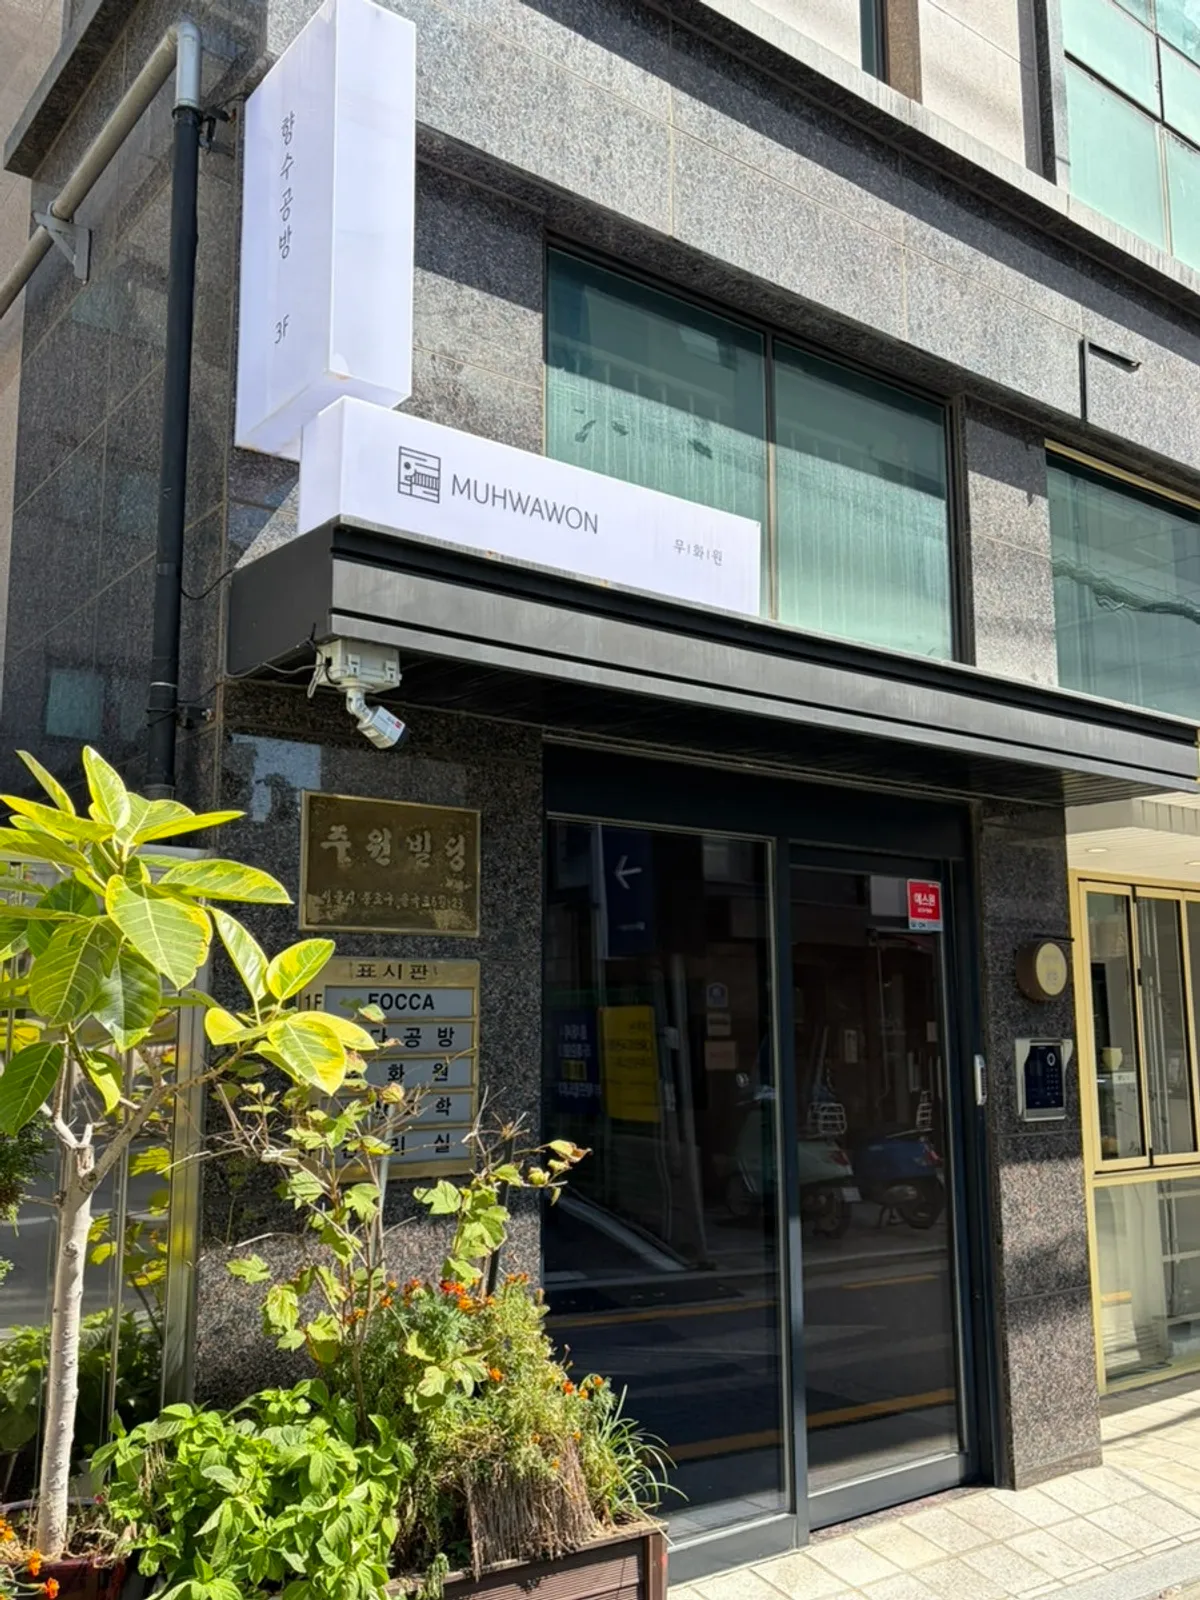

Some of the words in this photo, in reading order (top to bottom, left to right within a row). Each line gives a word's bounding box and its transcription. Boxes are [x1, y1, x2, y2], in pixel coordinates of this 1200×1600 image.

[278, 110, 295, 260] 향수공방
[274, 314, 290, 344] 3F
[451, 473, 599, 535] MUHWAWON
[304, 993, 323, 1011] 1F
